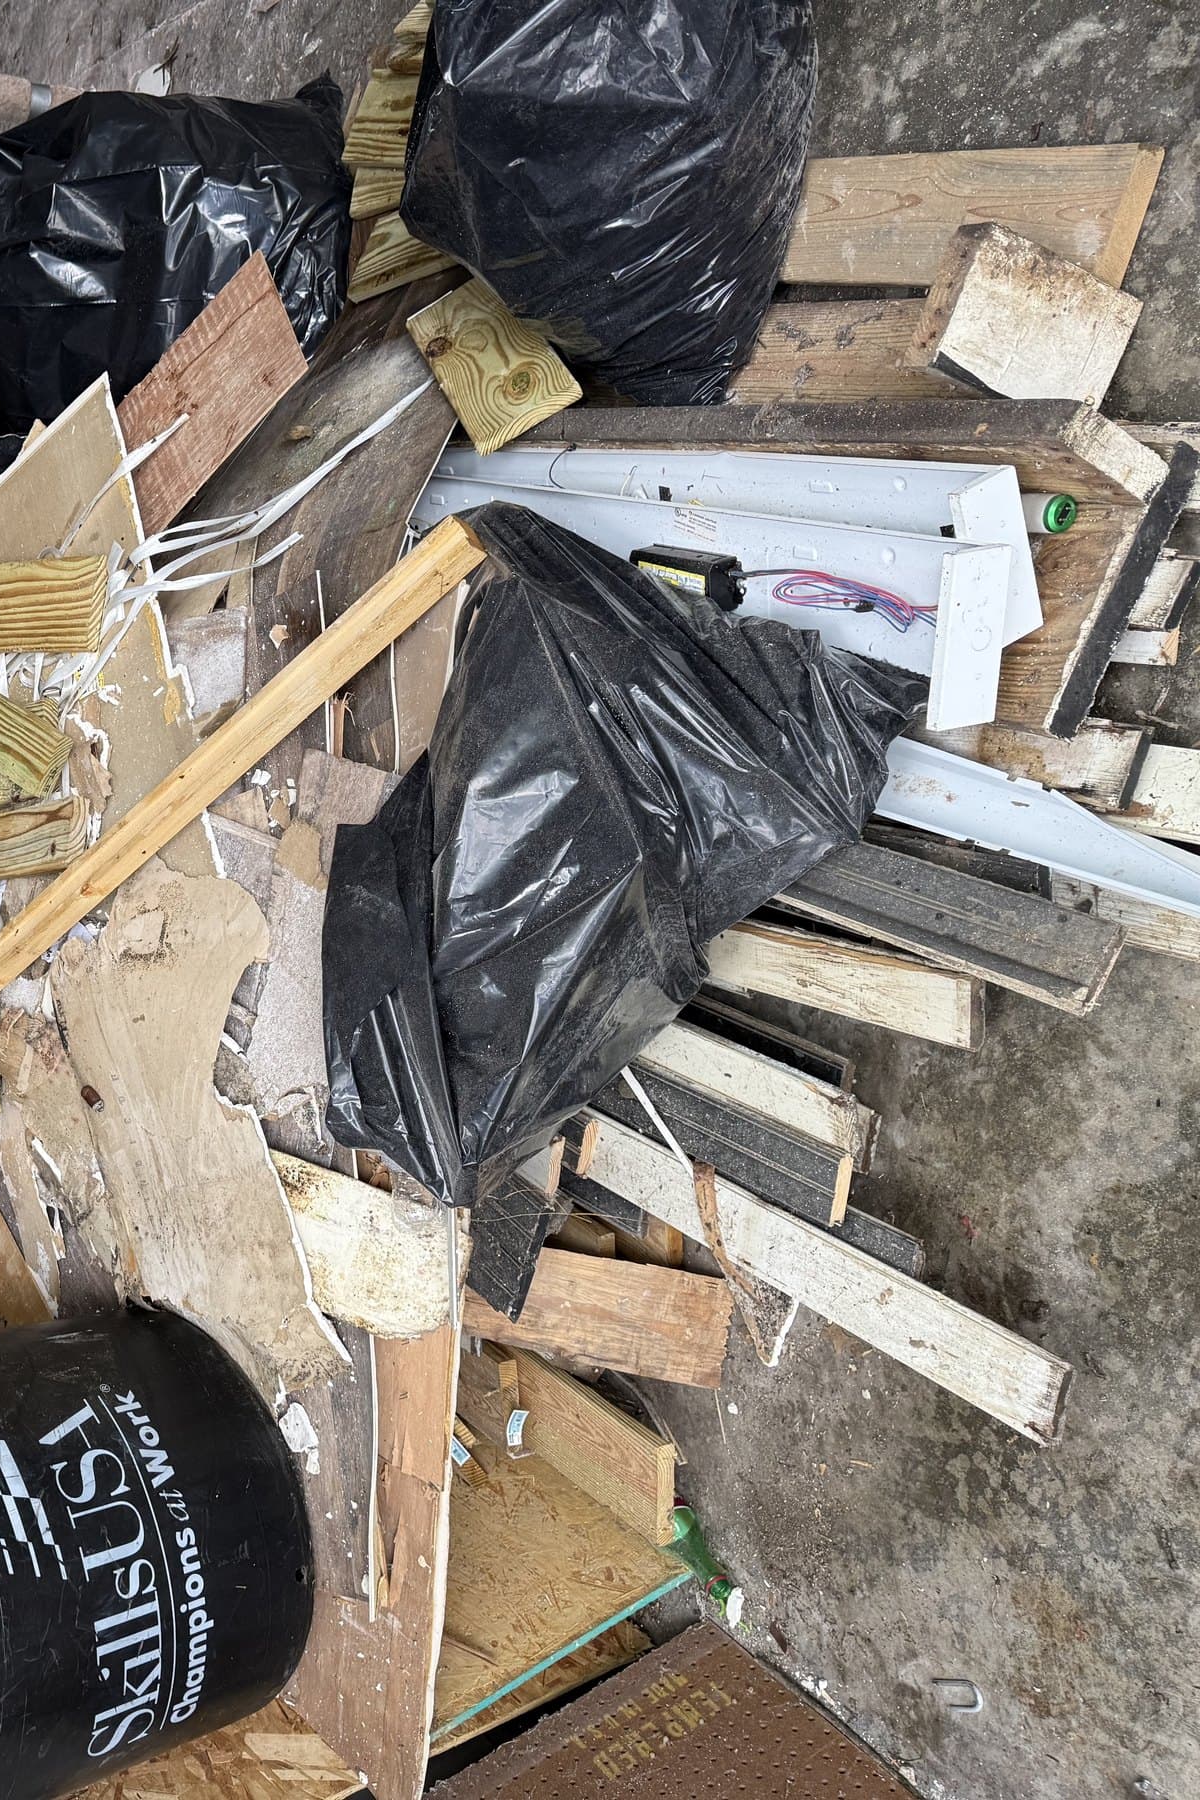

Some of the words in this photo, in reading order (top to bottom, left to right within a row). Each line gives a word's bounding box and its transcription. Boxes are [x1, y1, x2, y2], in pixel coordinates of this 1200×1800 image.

[113, 1388, 176, 1487] Work
[157, 1487, 189, 1521] at
[37, 1396, 163, 1757] SkillsUSA
[167, 1527, 214, 1723] Champions
